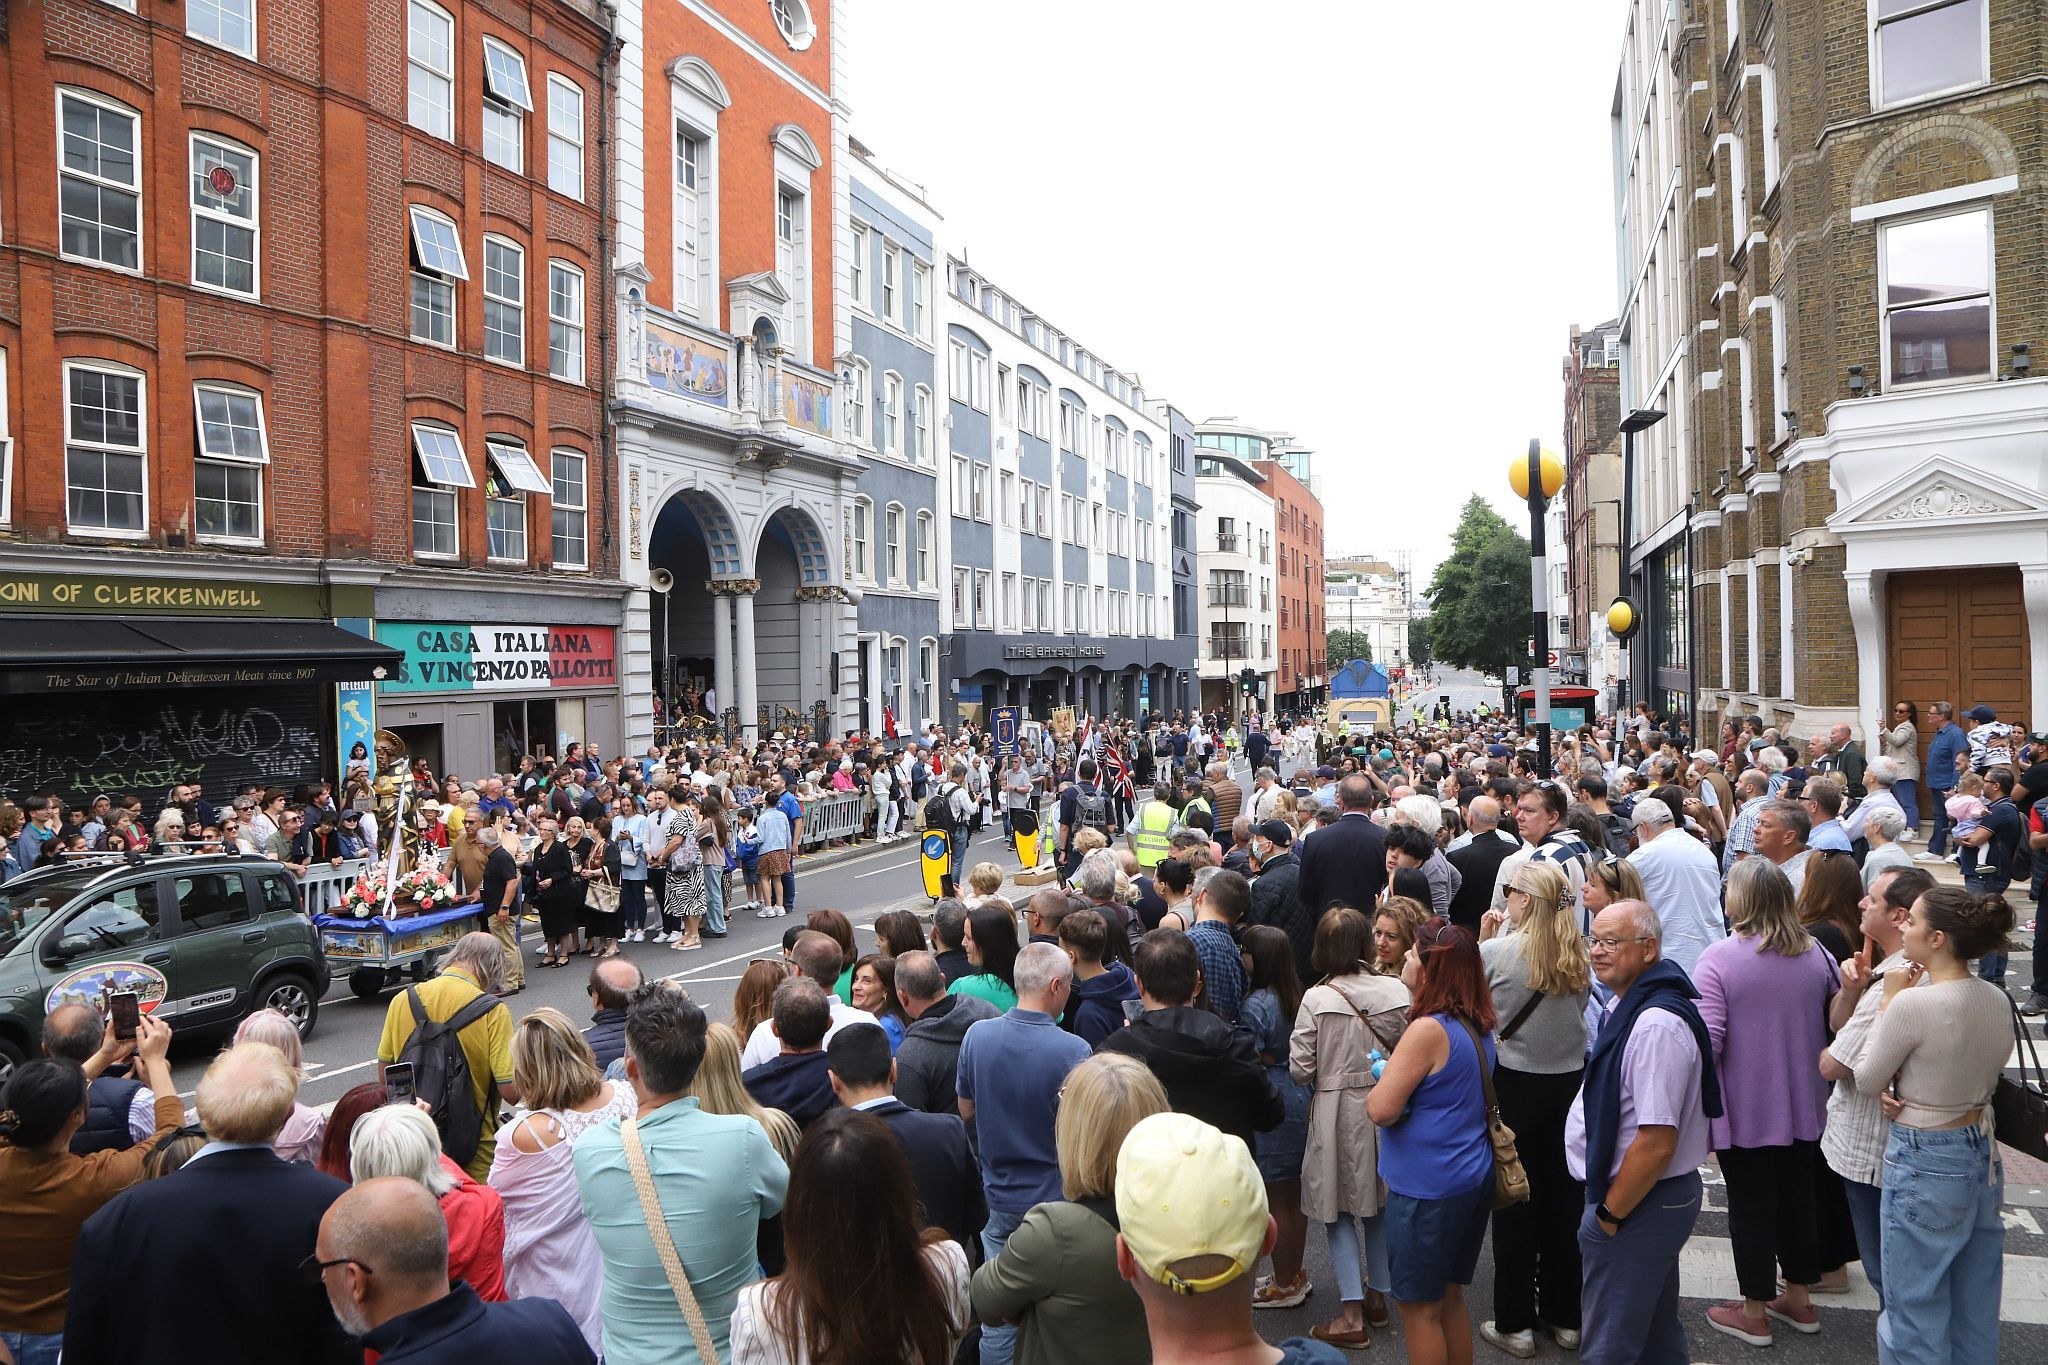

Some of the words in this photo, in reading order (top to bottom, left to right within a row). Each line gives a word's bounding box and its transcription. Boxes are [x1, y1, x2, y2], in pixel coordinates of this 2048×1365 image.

[0, 582, 39, 602] ONI
[52, 583, 83, 603] OF
[95, 585, 261, 607] CLERKENWELL
[417, 630, 481, 653] CASA
[494, 632, 593, 653] ITALIANA
[1010, 646, 1032, 656] THE
[1079, 646, 1106, 655] HOTEL
[47, 674, 70, 687] The
[76, 674, 101, 687] Star
[106, 674, 121, 688] of
[125, 673, 161, 684] Italian
[167, 671, 230, 683] Delicatessen
[236, 670, 264, 682] Meats
[268, 669, 292, 680] since
[296, 668, 315, 680] 1907
[418, 660, 528, 683] VINCENZO
[531, 658, 613, 680] PALLOTTI
